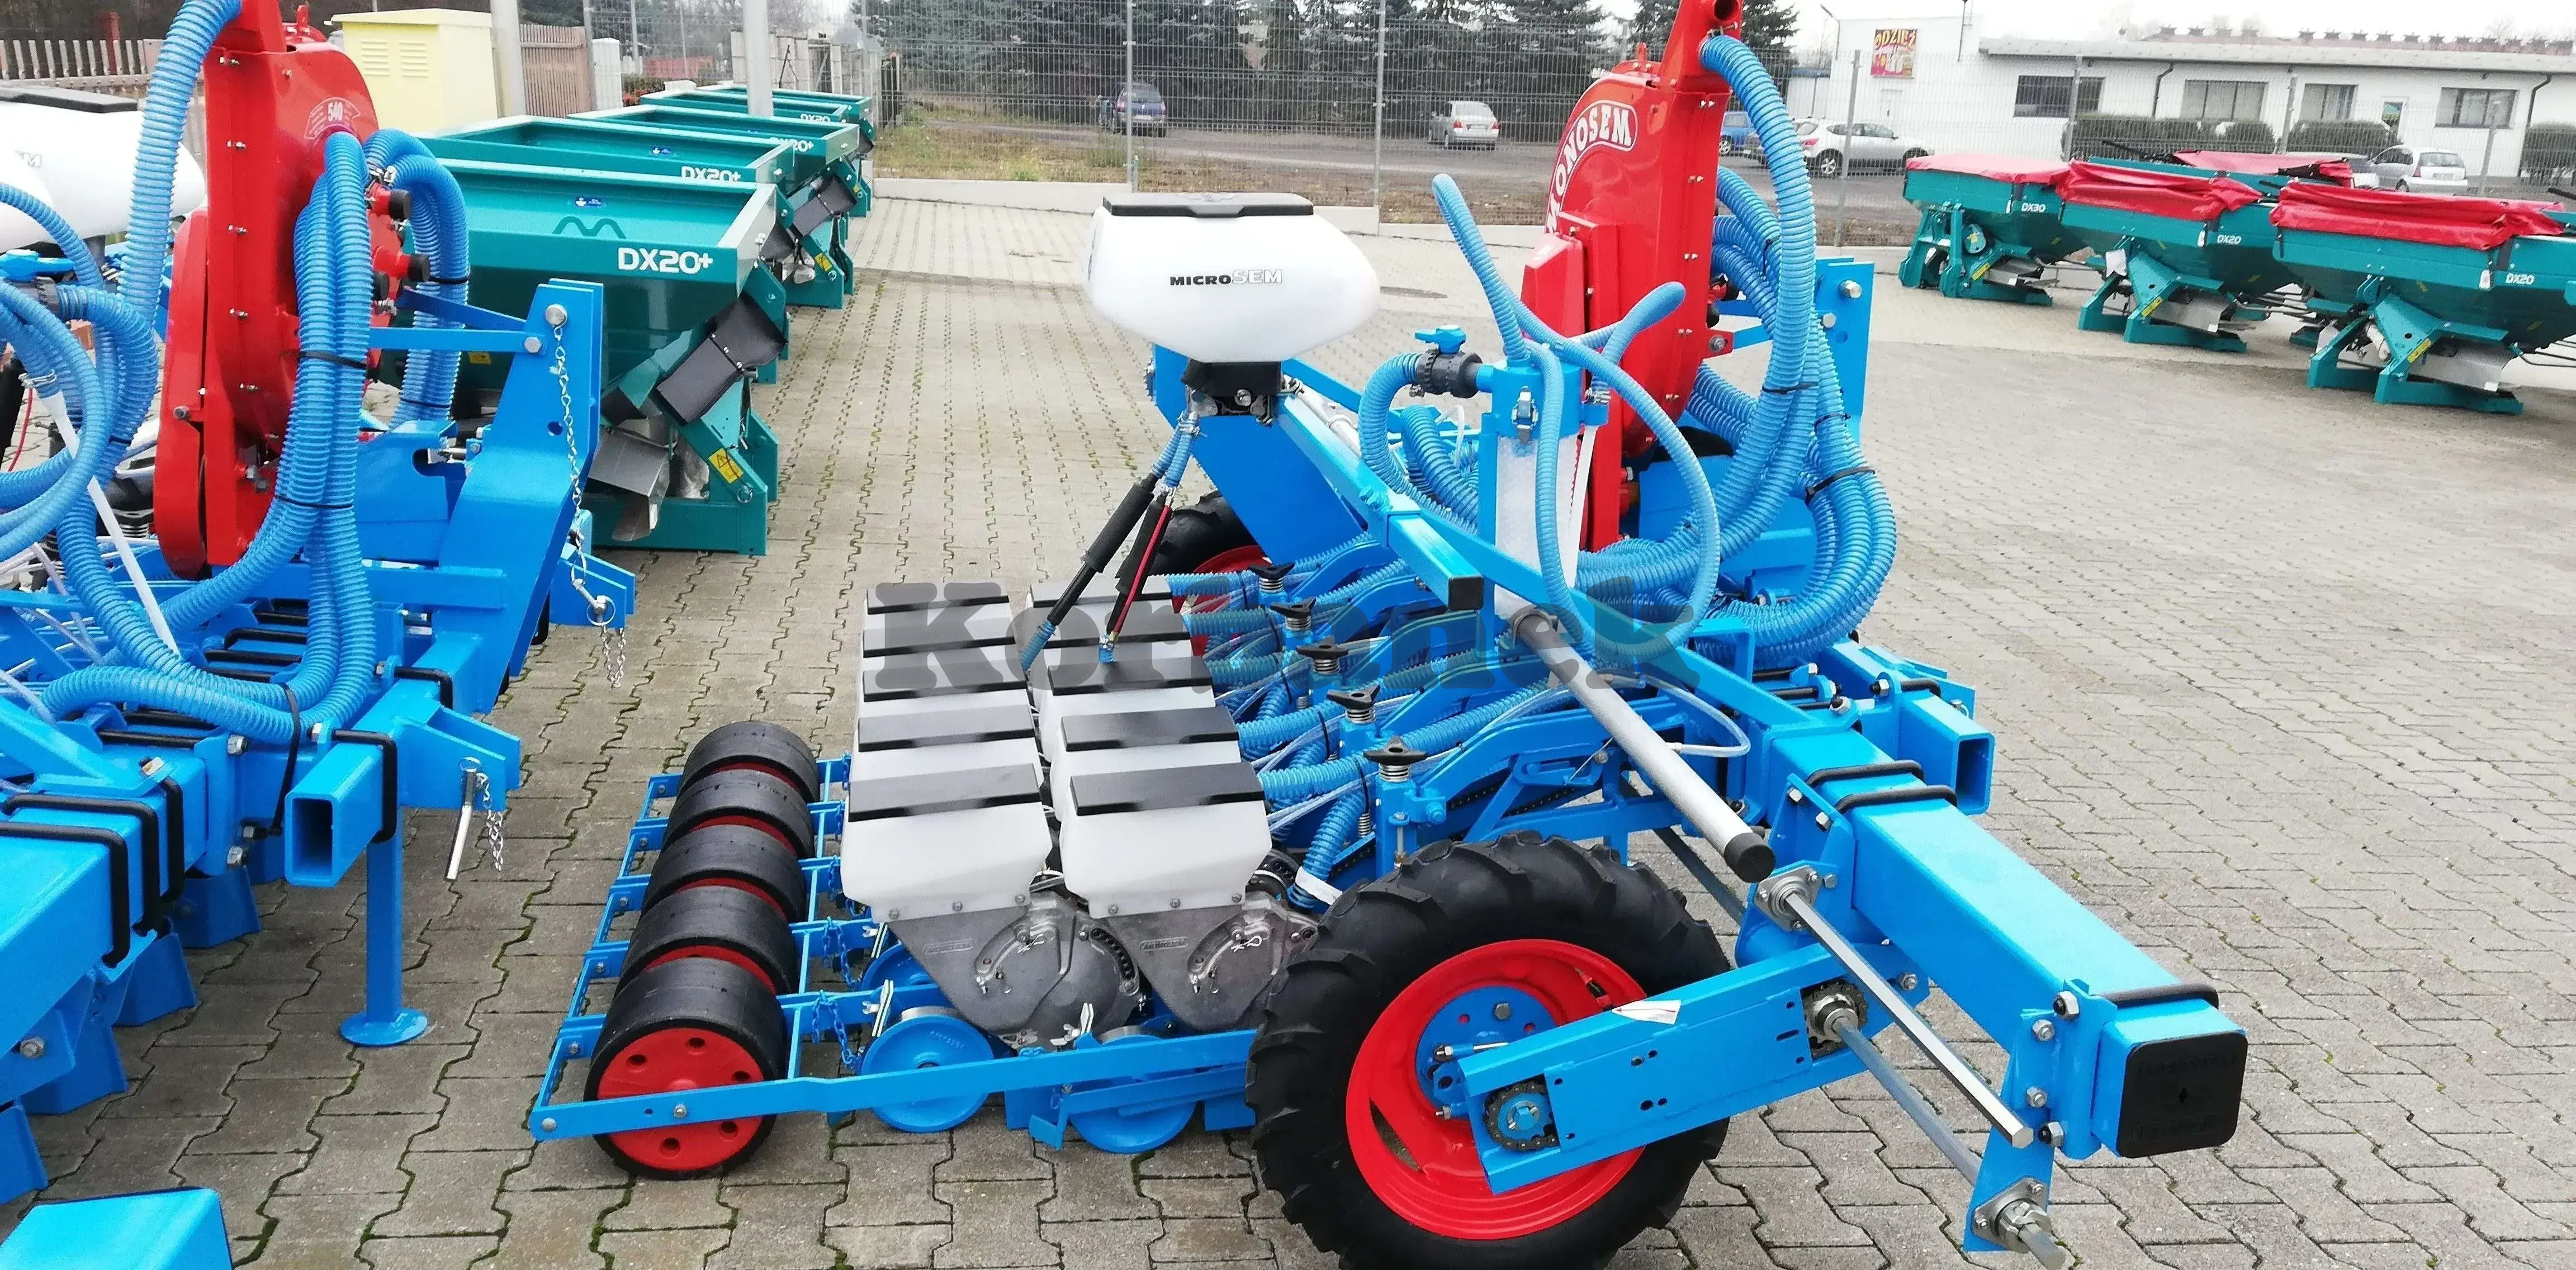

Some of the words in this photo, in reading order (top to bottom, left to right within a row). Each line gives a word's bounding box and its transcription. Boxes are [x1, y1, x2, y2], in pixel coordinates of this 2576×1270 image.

[681, 165, 742, 182] DX20+
[1546, 105, 1632, 233] MONOSEM
[2217, 234, 2242, 245] DX20
[618, 247, 713, 274] DX20+
[2505, 272, 2535, 285] DX20
